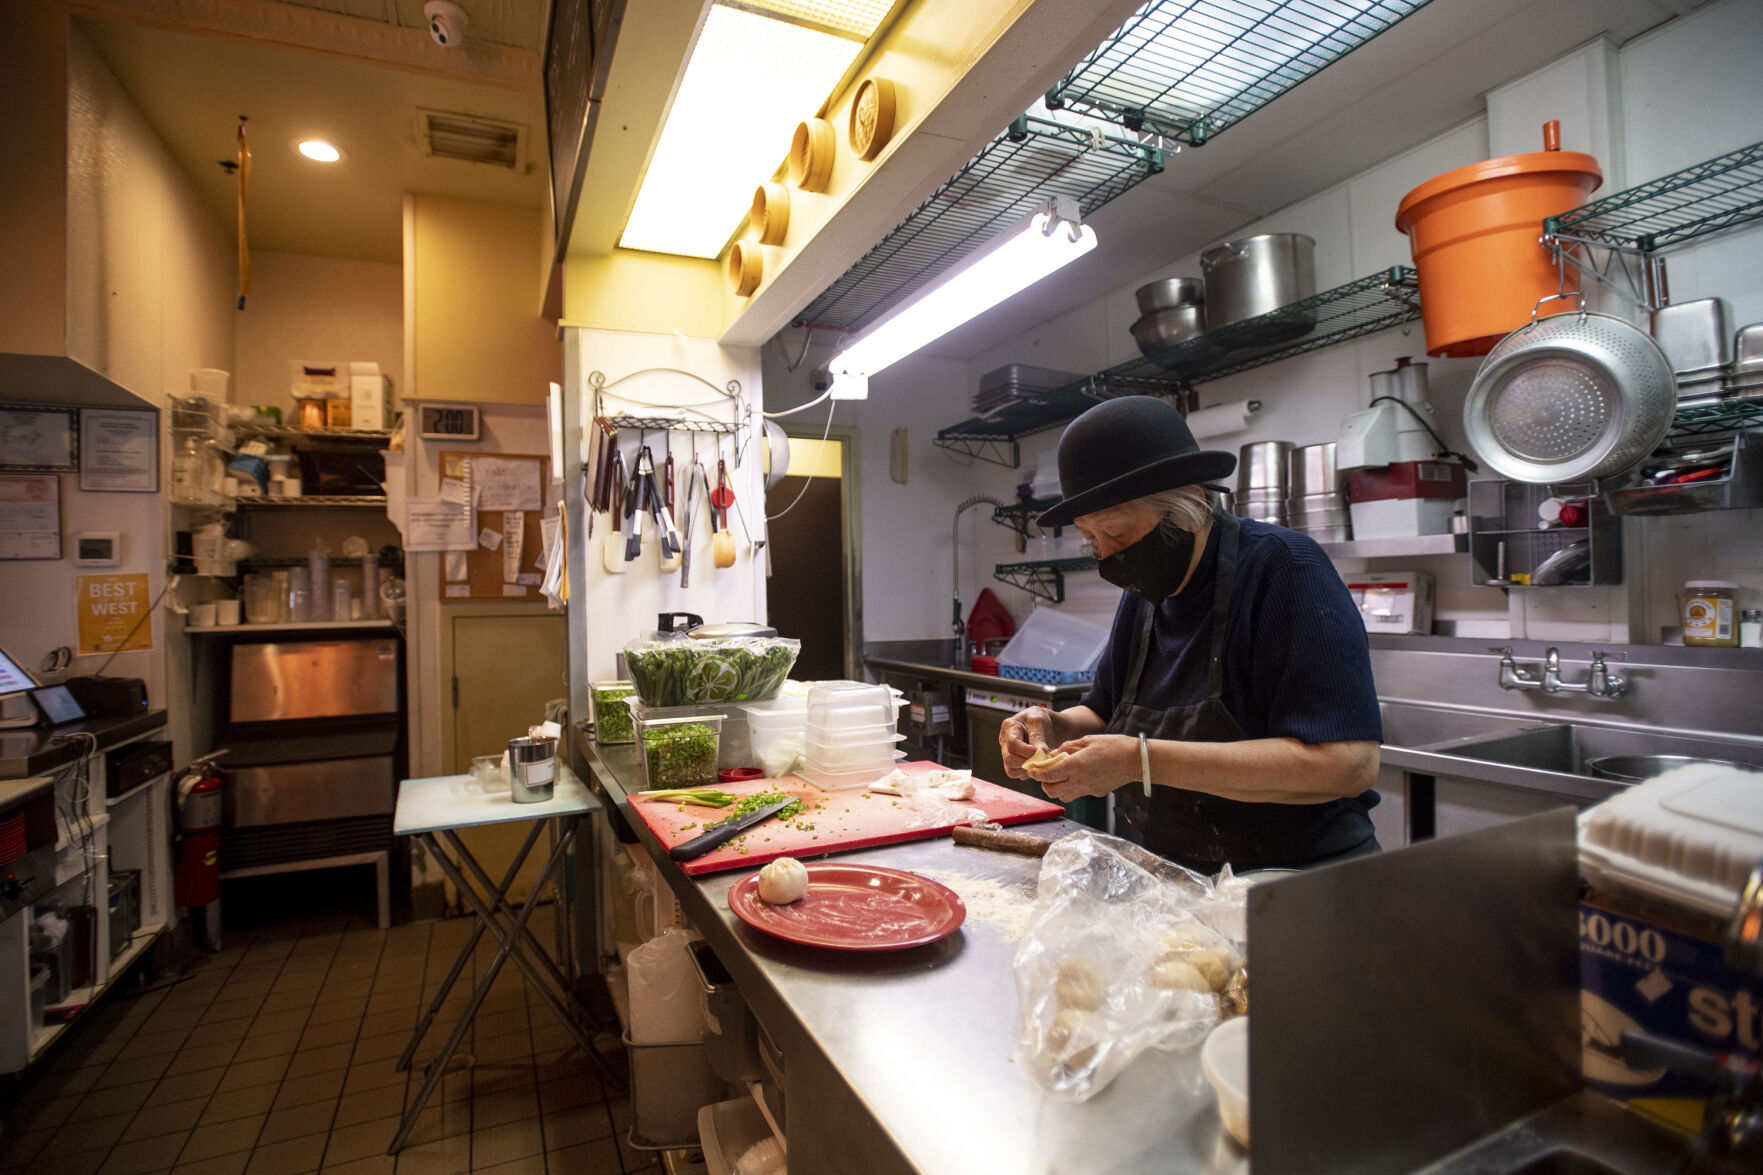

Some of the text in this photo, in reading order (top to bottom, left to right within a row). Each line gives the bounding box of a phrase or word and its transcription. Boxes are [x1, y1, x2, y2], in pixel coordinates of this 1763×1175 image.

[89, 582, 137, 598] BEST
[91, 601, 138, 616] WEST
[1687, 986, 1762, 1048] st
